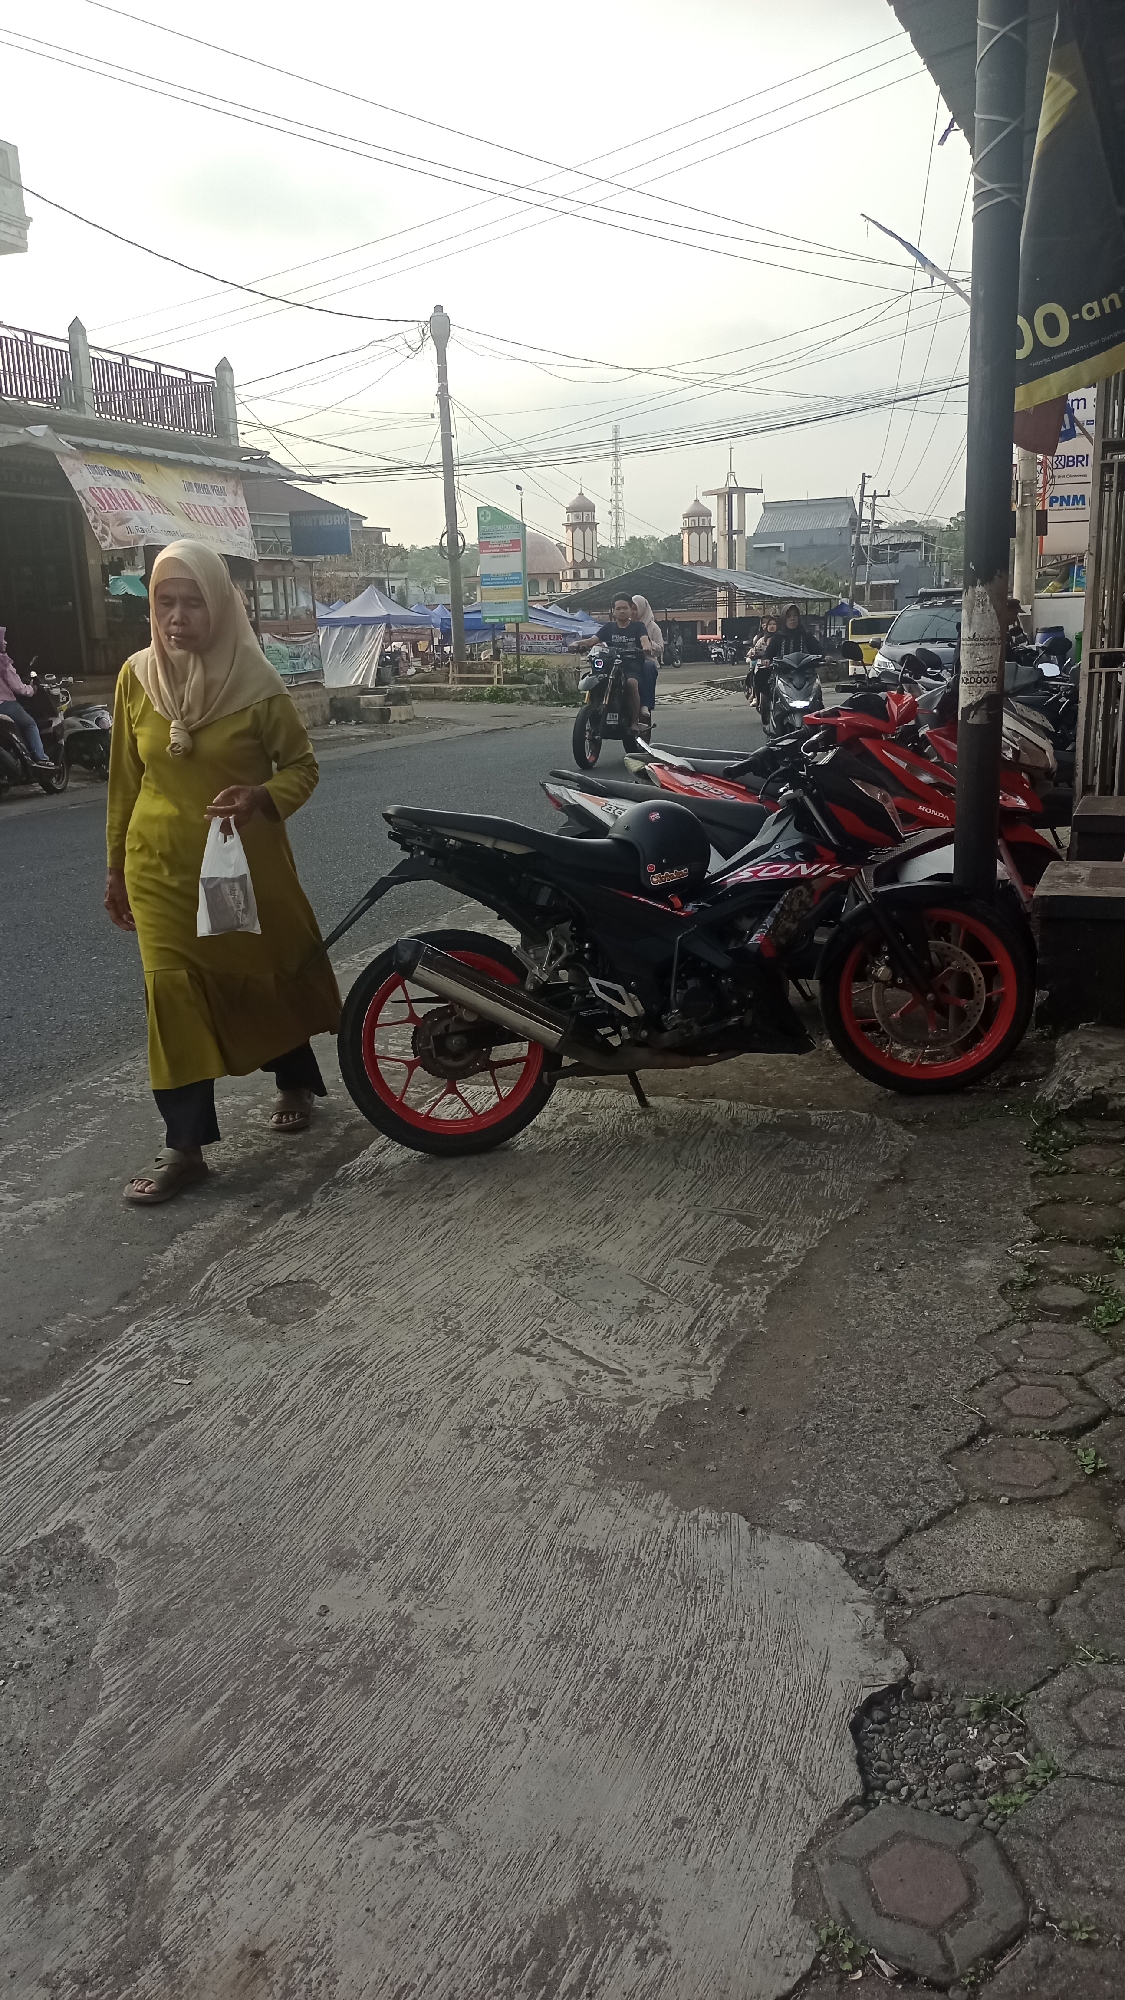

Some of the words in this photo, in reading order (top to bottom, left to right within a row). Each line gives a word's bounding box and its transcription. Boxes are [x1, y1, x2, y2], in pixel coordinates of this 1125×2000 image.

[1066, 454, 1089, 468] BRI
[89, 486, 144, 511] SINAR
[1049, 494, 1086, 507] PNM
[177, 501, 229, 527] PELITA
[917, 805, 950, 821] HONDA
[726, 862, 856, 882] SONIC
